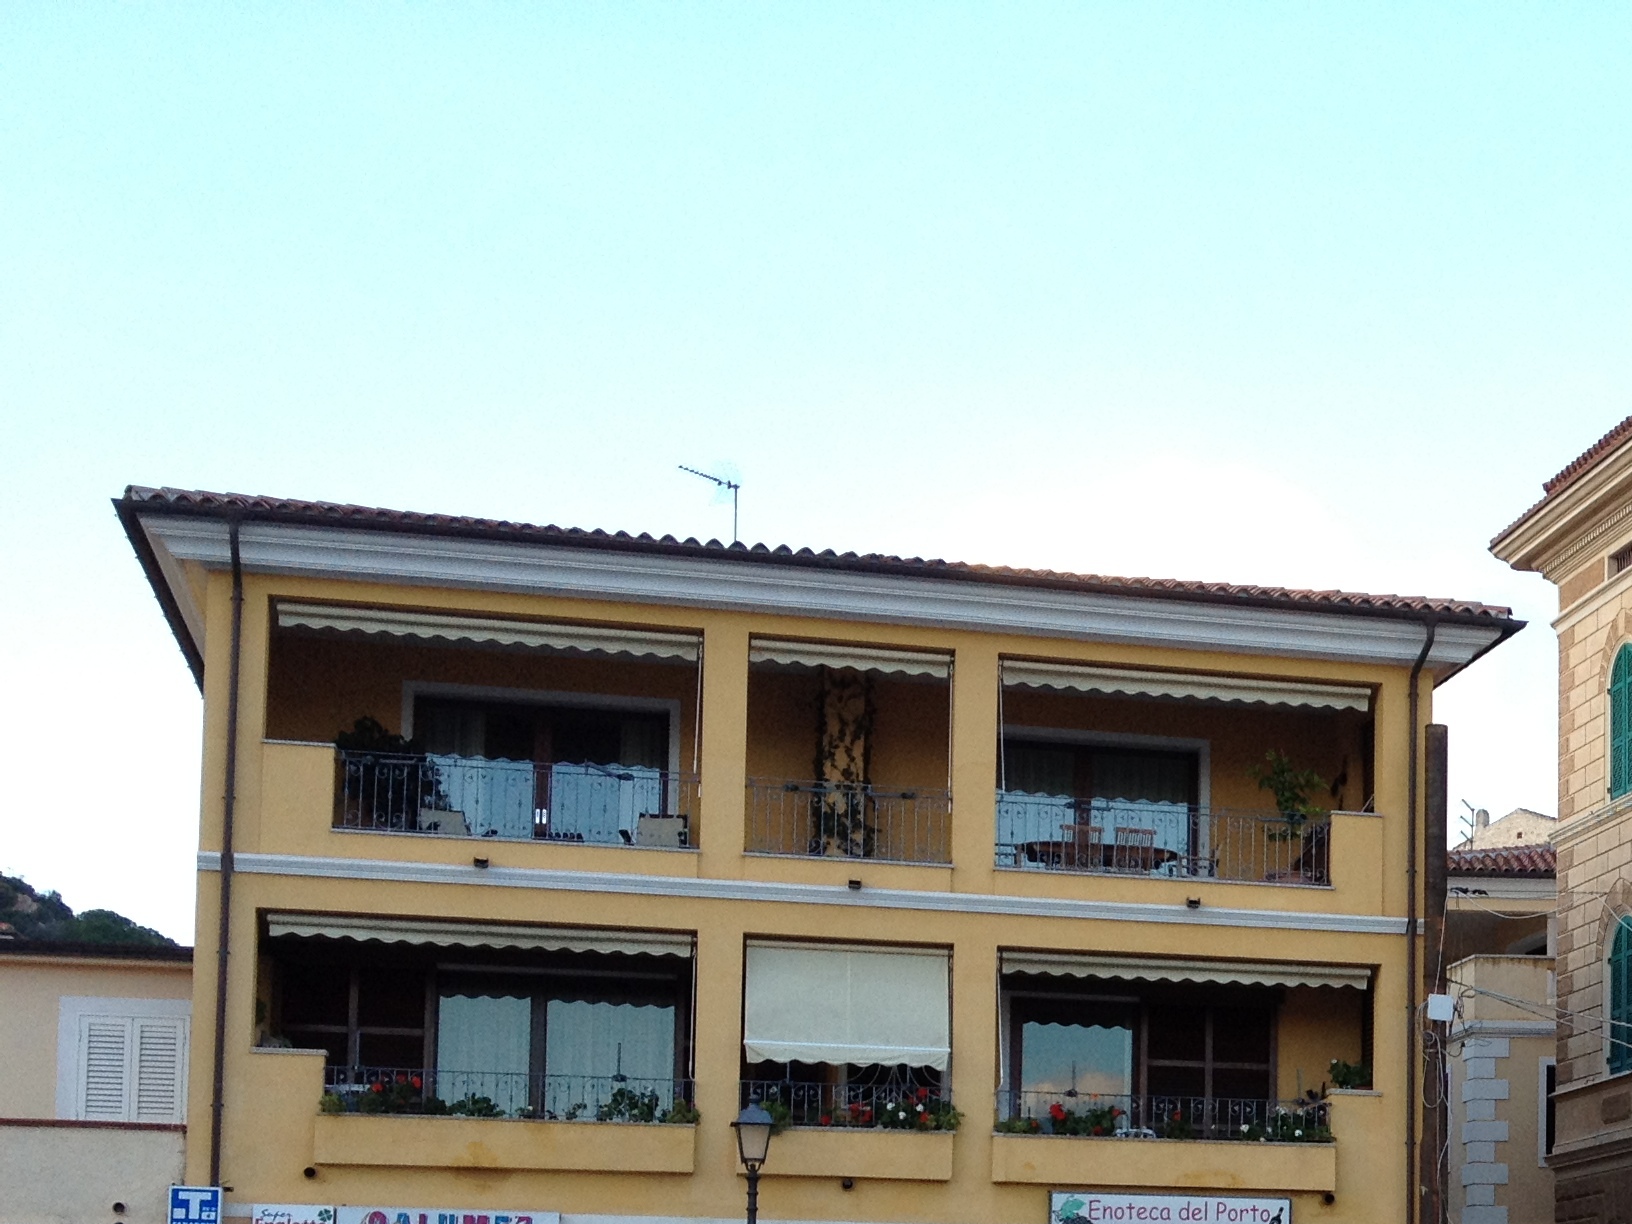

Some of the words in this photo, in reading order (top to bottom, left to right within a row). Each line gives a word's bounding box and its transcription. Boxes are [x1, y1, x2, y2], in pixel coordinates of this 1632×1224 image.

[261, 1208, 293, 1222] Super
[1088, 1199, 1171, 1221] Enoteca
[1178, 1200, 1208, 1221] del
[1216, 1201, 1270, 1223] Porto
